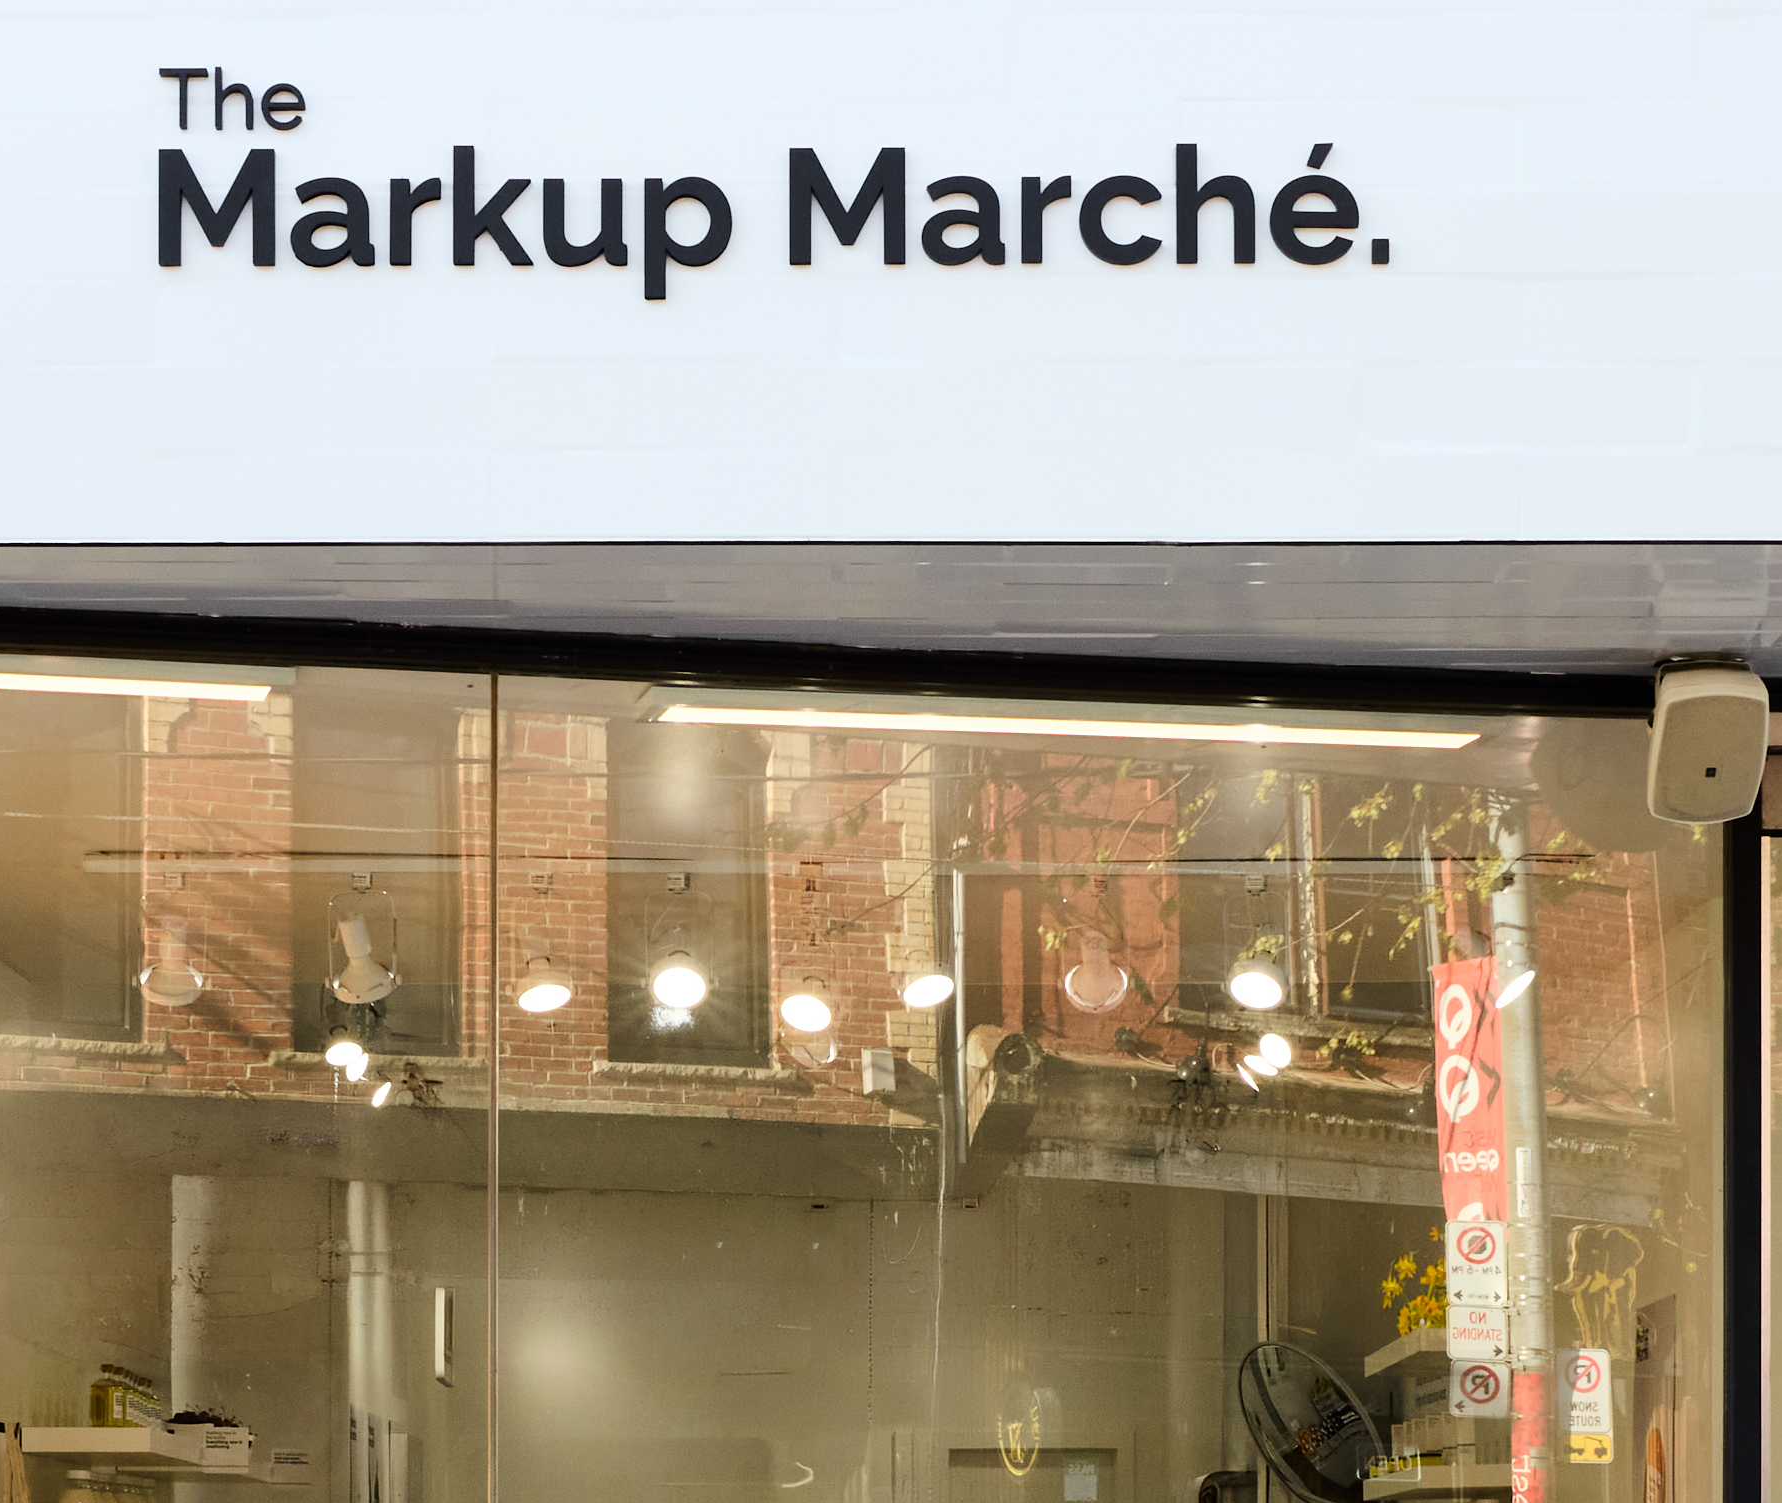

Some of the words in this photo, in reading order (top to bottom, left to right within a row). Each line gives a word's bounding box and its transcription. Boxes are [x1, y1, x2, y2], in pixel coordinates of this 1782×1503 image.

[159, 66, 306, 131] The
[158, 145, 733, 301] Markup
[789, 142, 1390, 267] Marché.
